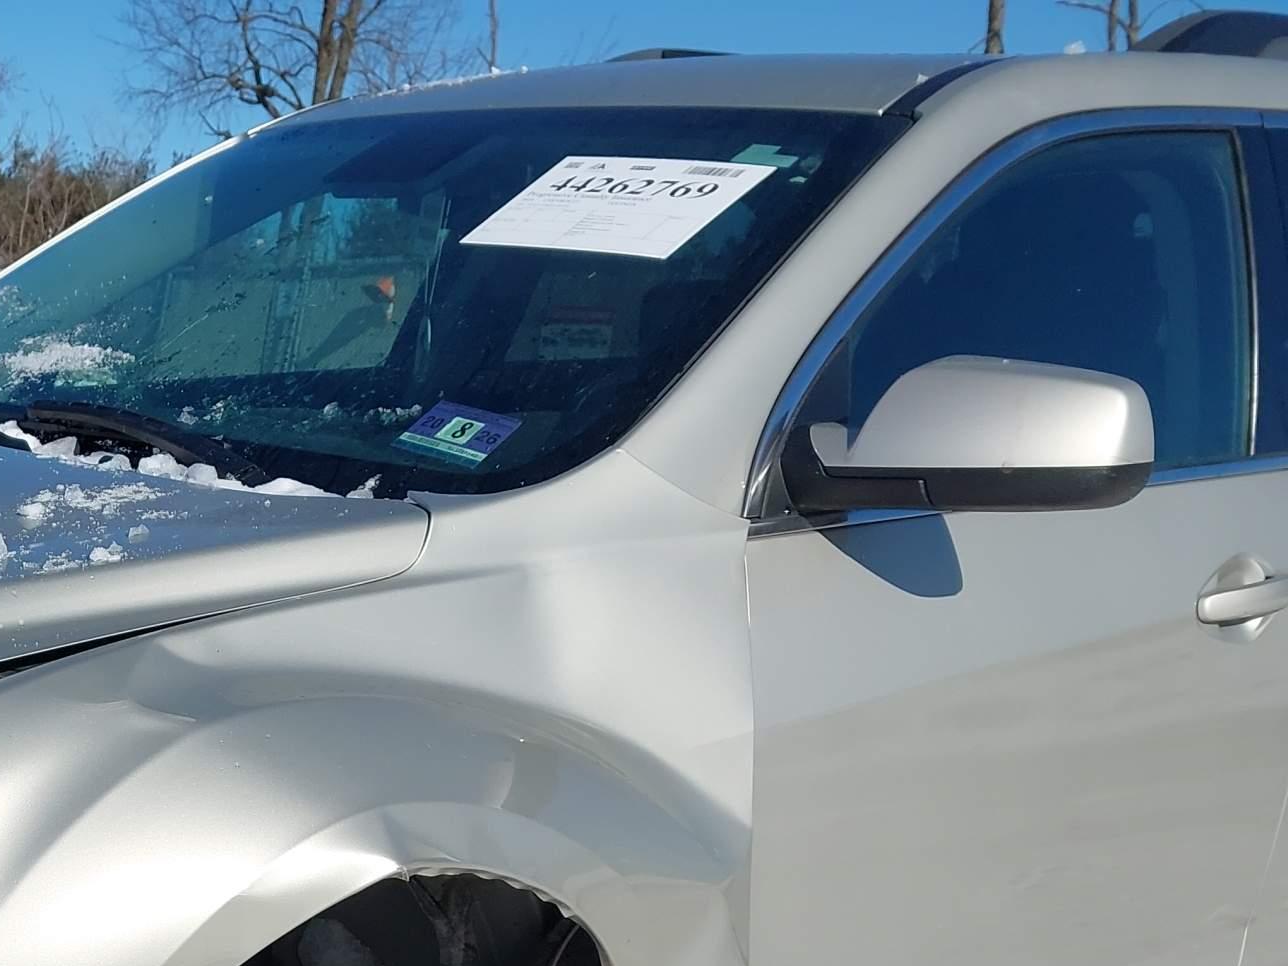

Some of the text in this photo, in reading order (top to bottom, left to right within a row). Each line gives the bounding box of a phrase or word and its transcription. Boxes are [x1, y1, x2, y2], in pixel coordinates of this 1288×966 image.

[550, 175, 719, 199] 44262769
[421, 415, 501, 445] 20 8 26
